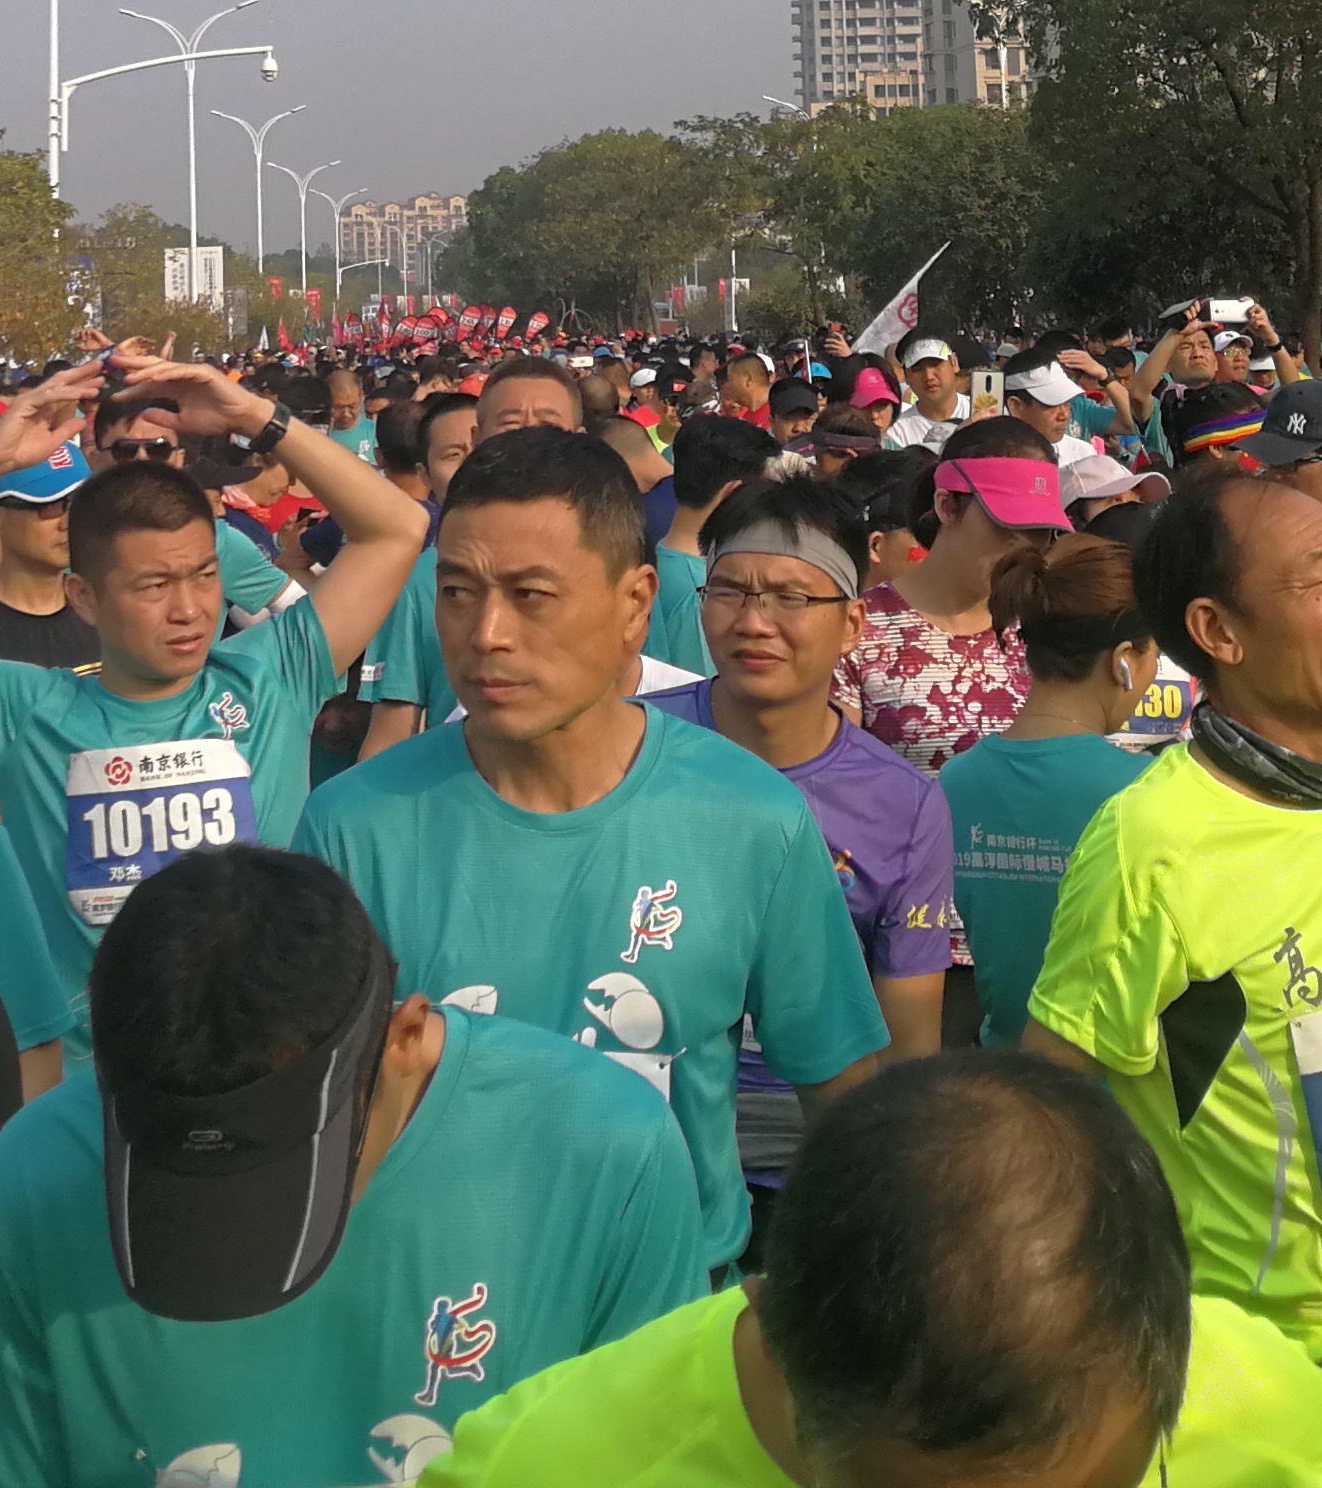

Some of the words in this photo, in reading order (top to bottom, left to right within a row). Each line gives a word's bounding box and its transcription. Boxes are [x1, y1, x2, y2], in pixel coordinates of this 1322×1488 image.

[138, 750, 205, 775] 南京银行
[83, 787, 237, 860] 10193
[953, 851, 1069, 874] 19高淳国际慢城马
